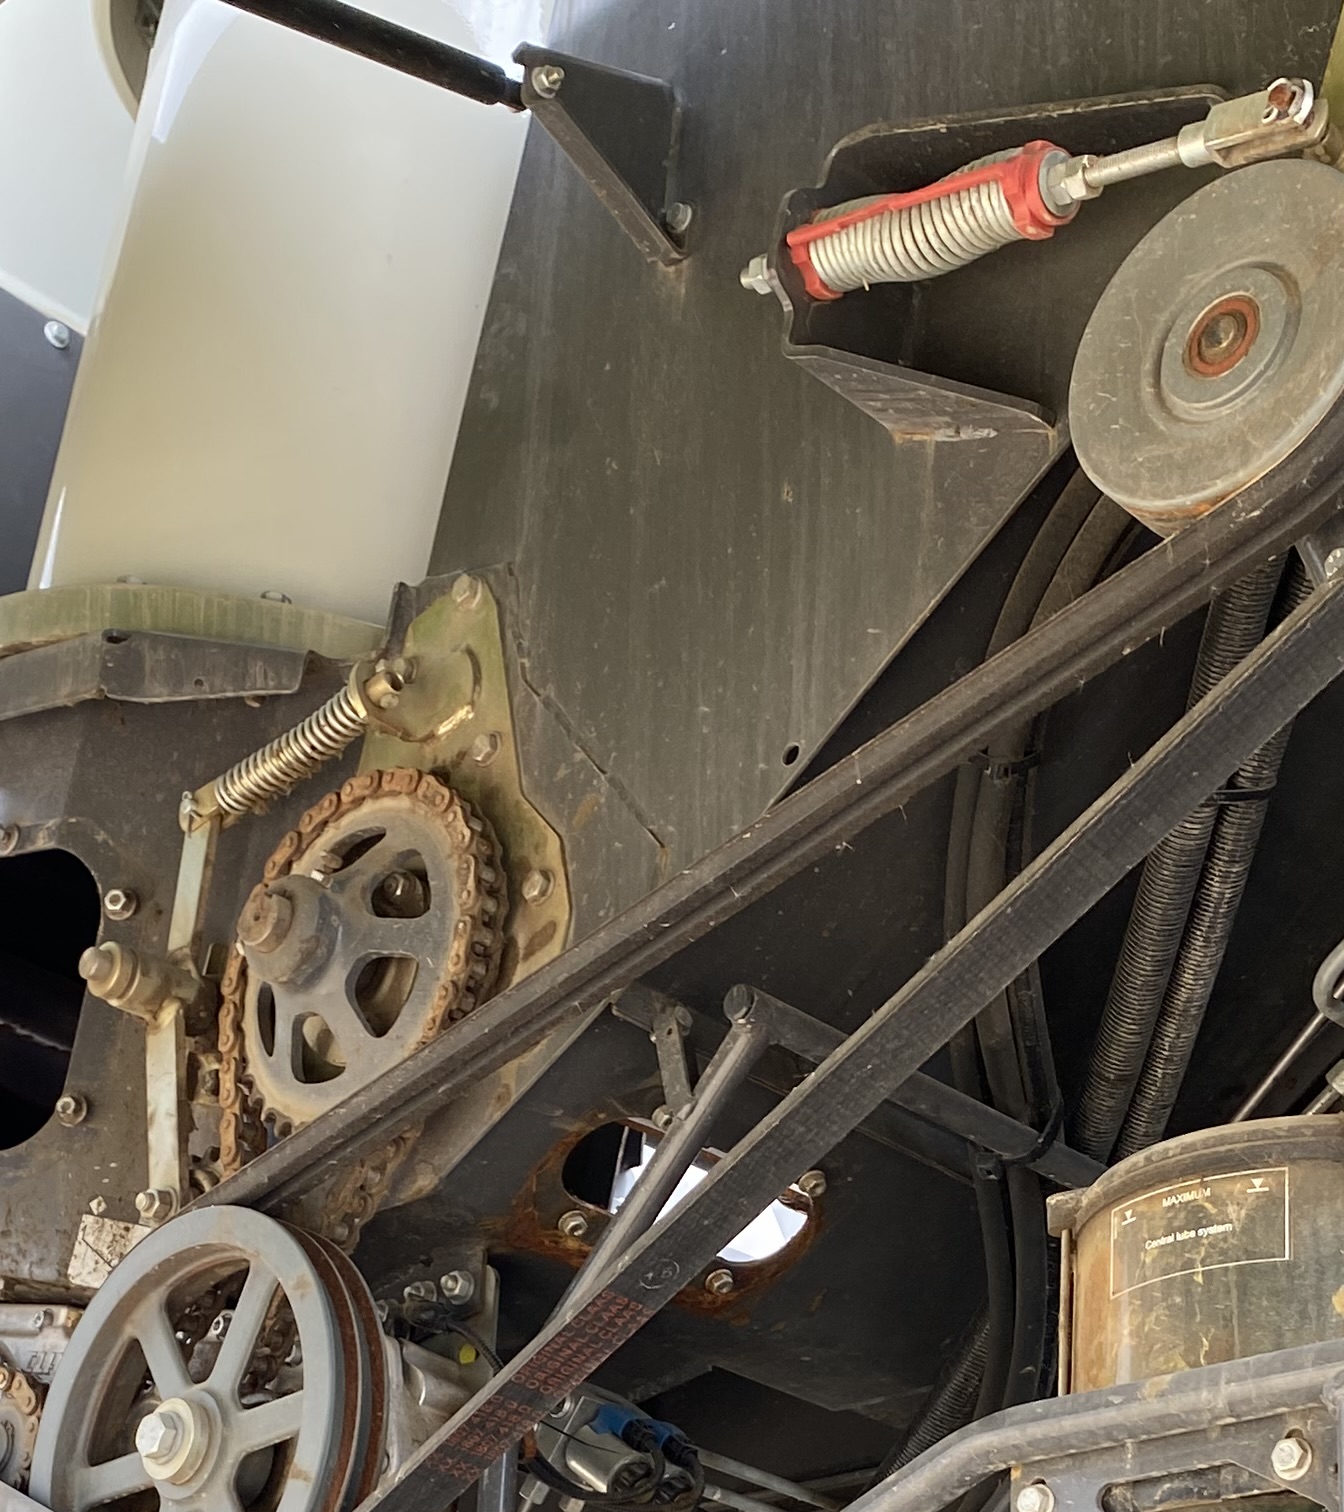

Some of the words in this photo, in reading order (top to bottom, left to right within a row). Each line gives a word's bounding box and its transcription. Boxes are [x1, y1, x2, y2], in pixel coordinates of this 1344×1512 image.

[1145, 1234, 1175, 1250] Central
[1176, 1228, 1196, 1241] lube
[1197, 1222, 1233, 1237] system
[1162, 1188, 1211, 1207] MAXIMUM
[512, 1331, 575, 1383] ORIGINAL
[571, 1290, 614, 1328] CLAAS
[526, 1336, 590, 1389] ORIGINAL
[586, 1298, 628, 1333] CLAAS
[539, 1342, 603, 1395] ORIGINAL
[600, 1302, 642, 1339] CLAAS
